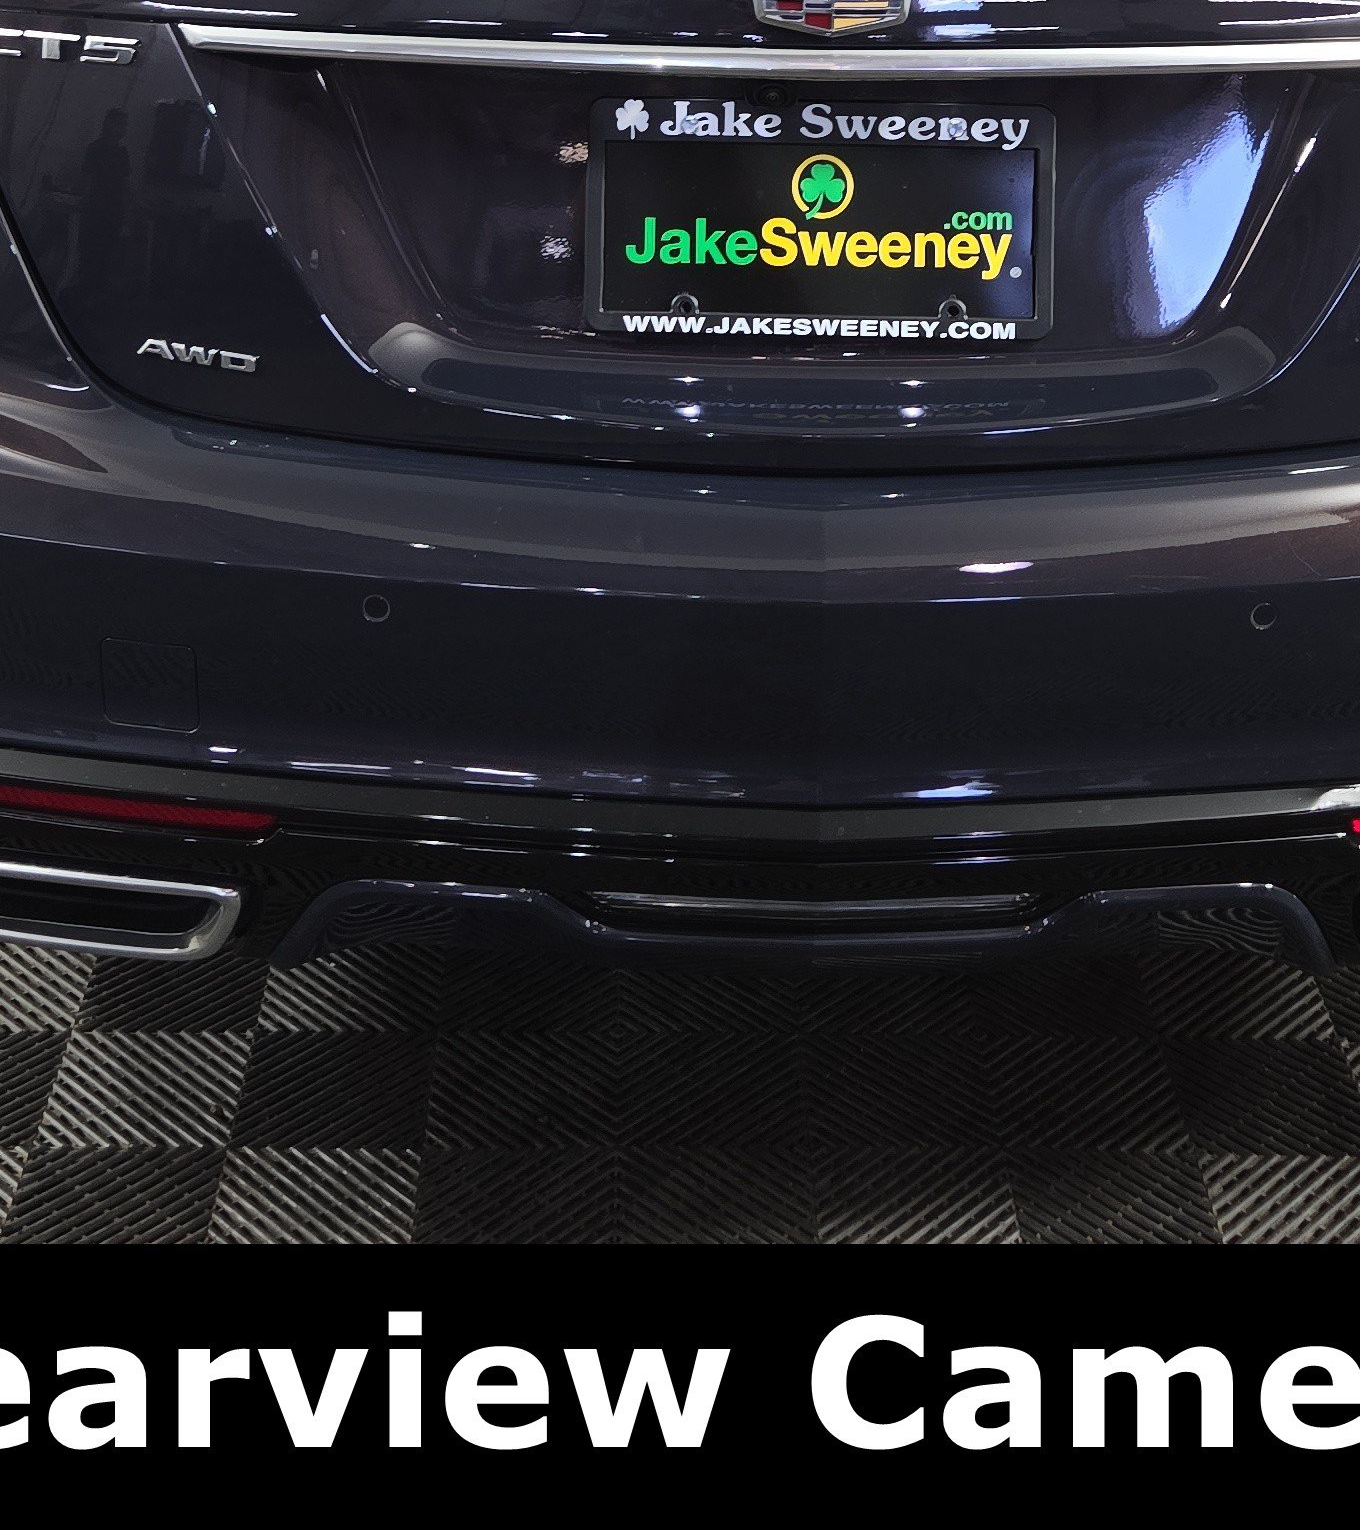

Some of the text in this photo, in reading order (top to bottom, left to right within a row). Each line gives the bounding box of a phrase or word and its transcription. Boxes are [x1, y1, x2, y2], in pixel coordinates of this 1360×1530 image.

[660, 100, 1030, 150] Jake Sweeney
[623, 314, 1016, 340] WWW.JAKESWEENEY.COM
[137, 338, 260, 373] AWD
